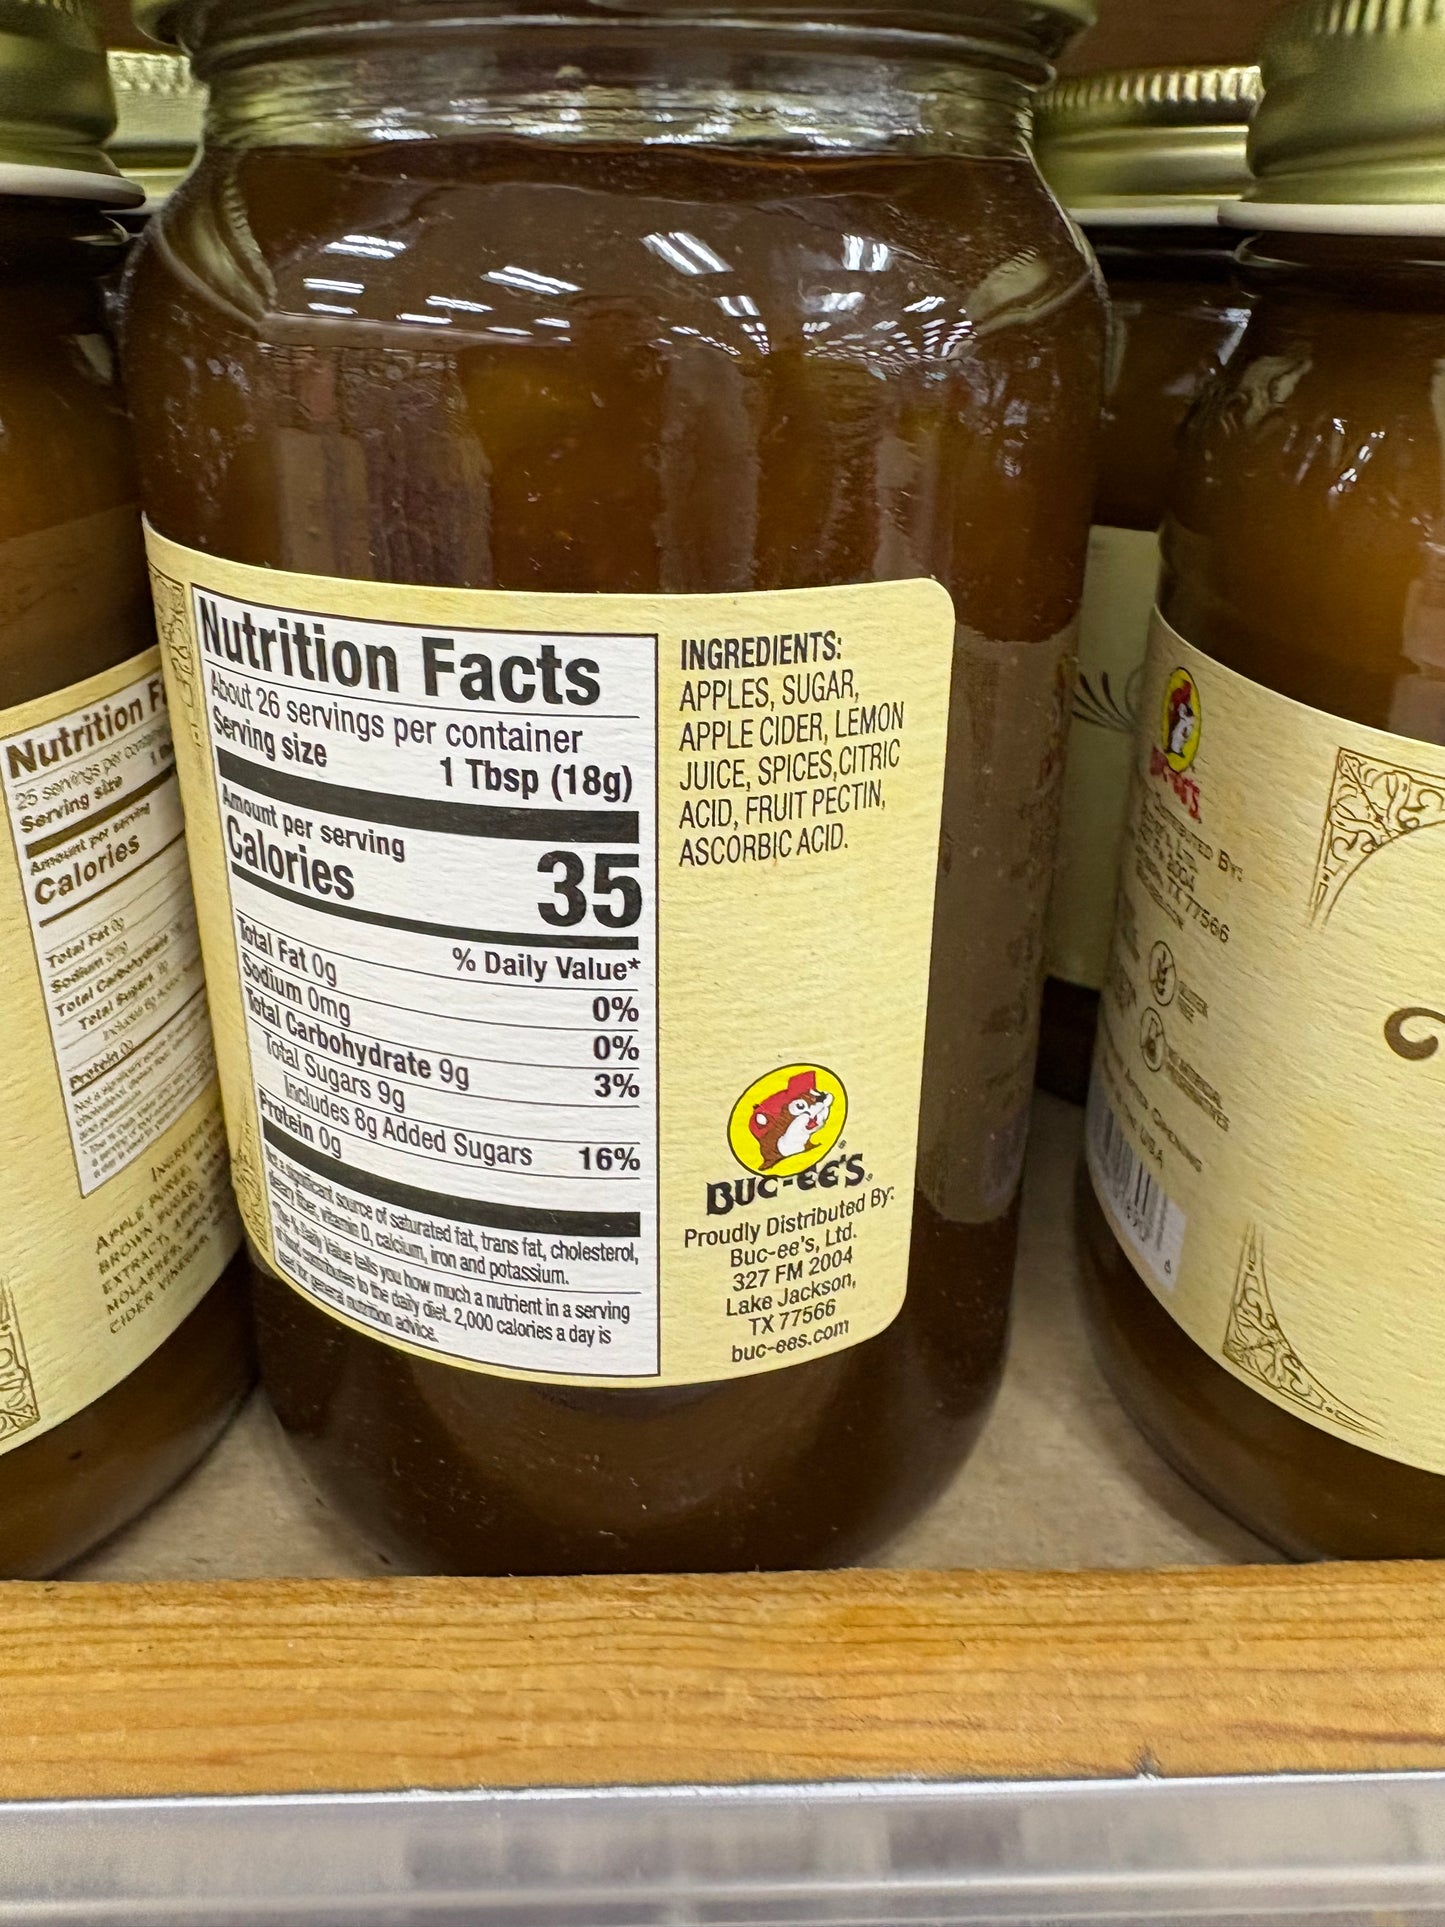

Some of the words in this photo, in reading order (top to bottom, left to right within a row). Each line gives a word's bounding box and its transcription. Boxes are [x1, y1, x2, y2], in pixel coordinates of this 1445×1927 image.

[199, 596, 399, 692] Nutrition
[421, 636, 601, 706] Facts
[681, 630, 843, 670] INGREDIENTS:
[211, 669, 254, 711] About
[256, 687, 280, 719] 26
[286, 700, 385, 739] servings
[394, 716, 437, 746] per
[445, 720, 583, 754] container
[679, 677, 775, 712] APPLES,
[782, 669, 860, 706] SUGAR,
[5, 698, 144, 779] Nutrition
[213, 705, 276, 762] Serving
[281, 732, 328, 768] size
[678, 719, 754, 752] APPLE
[759, 712, 829, 747] CIDER,
[835, 701, 905, 739] LEMON
[15, 788, 38, 811] 25
[440, 756, 453, 787] 1
[465, 758, 539, 800] Tbsp
[551, 763, 634, 803] (18g)
[679, 759, 751, 792] JUICE,
[20, 793, 90, 833] Serving
[222, 783, 278, 829] Amount
[282, 813, 313, 837] per
[320, 824, 406, 863] serving
[678, 798, 739, 831] ACID,
[746, 791, 808, 826] FRUIT
[812, 779, 886, 817] PECTIN,
[35, 834, 141, 905] Calories
[227, 814, 355, 900] Calories
[536, 850, 642, 928] 35
[678, 829, 793, 868] ASCORBIC
[796, 822, 849, 856] ACID.
[236, 914, 274, 958] Total
[278, 937, 309, 973] Fat
[312, 953, 337, 988] 0g
[592, 996, 640, 1024] 0%
[452, 947, 476, 972] %
[484, 951, 548, 983] Daily
[242, 951, 303, 1005] Sodium
[308, 986, 351, 1028] 0mg
[592, 1035, 640, 1061] 0%
[245, 986, 282, 1029] Total
[286, 1010, 432, 1079] Carbohydrate
[439, 1058, 470, 1092] 9g
[593, 1073, 640, 1098] 3%
[263, 1030, 300, 1071] Total
[304, 1053, 371, 1099] Sugars
[378, 1079, 405, 1114] 9g
[258, 1088, 314, 1143] Protein
[319, 1126, 341, 1159] 0g
[284, 1075, 350, 1125] Includes
[355, 1107, 377, 1140] 8g
[382, 1117, 447, 1154] Added
[454, 1133, 533, 1167] Sugars
[578, 1147, 641, 1171] 16%
[389, 1213, 452, 1243] saturated
[454, 1226, 478, 1252] fat,
[480, 1231, 519, 1255] trans
[522, 1237, 547, 1262] fat,
[550, 1240, 639, 1266] cholesterol,
[684, 1221, 761, 1249] Proudly
[766, 1192, 866, 1237] Distributed
[870, 1185, 896, 1209] By:
[375, 1232, 428, 1264] calcium,
[430, 1244, 457, 1269] iron
[460, 1256, 486, 1275] and
[490, 1260, 570, 1285] potassium.
[730, 1235, 820, 1268] Buc-ee's,
[825, 1221, 858, 1248] Ltd.
[732, 1268, 770, 1293] 327
[775, 1260, 803, 1285] FM
[808, 1245, 853, 1277] 2004
[379, 1265, 402, 1286] you
[403, 1269, 430, 1294] how
[434, 1284, 471, 1305] much
[474, 1292, 483, 1307] a
[487, 1293, 543, 1316] nutrient
[546, 1297, 559, 1317] in
[563, 1303, 572, 1319] a
[575, 1300, 630, 1325] serving
[391, 1290, 419, 1318] daily
[453, 1307, 494, 1333] 2,000
[496, 1318, 553, 1341] calories
[556, 1327, 566, 1342] a
[569, 1324, 595, 1348] day
[598, 1325, 612, 1345] is
[725, 1292, 773, 1317] Lake
[777, 1272, 858, 1309] Jackson,
[750, 1313, 775, 1337] TX
[779, 1298, 837, 1331] 77566
[731, 1318, 850, 1363] buc-ees.com
